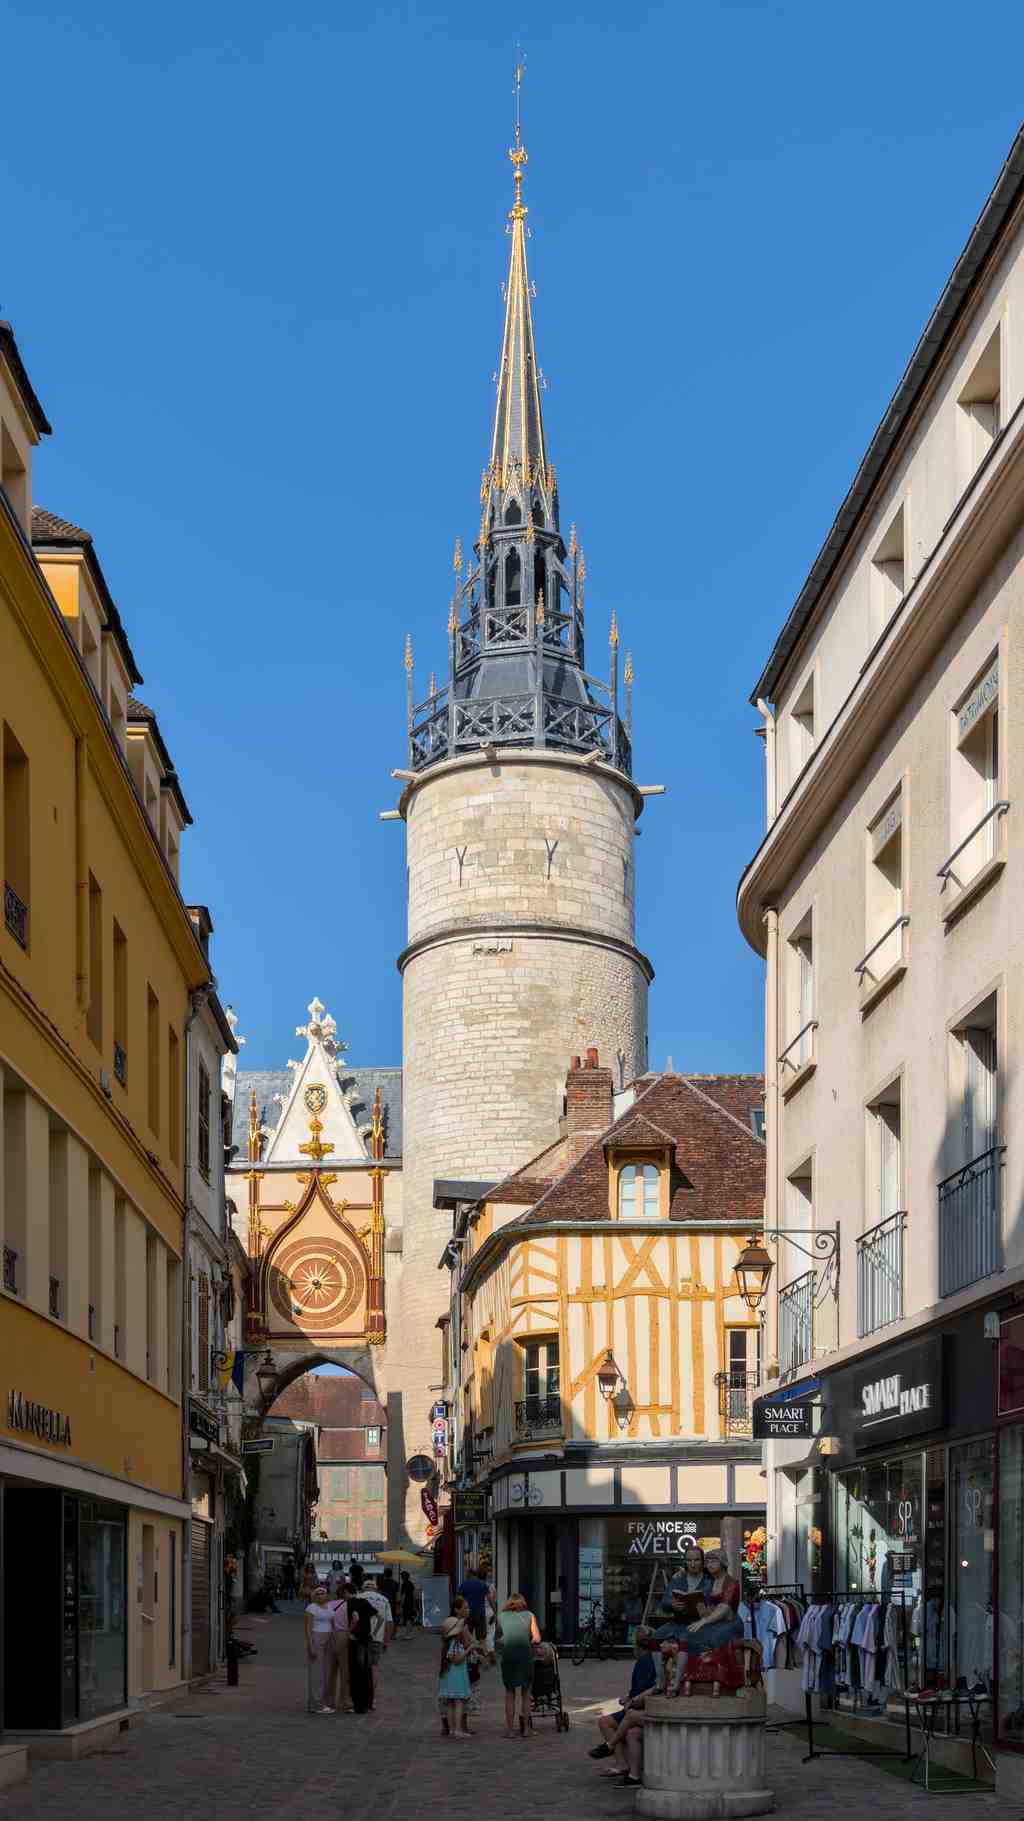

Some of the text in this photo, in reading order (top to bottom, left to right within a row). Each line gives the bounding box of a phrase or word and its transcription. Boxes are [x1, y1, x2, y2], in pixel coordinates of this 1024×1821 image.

[863, 1375, 932, 1415] SMART PLACE
[765, 1407, 803, 1419] SMART
[434, 1407, 446, 1456] LOTO
[770, 1423, 799, 1433] PLACE
[627, 1521, 683, 1533] FRANCE
[898, 1501, 912, 1535] SP
